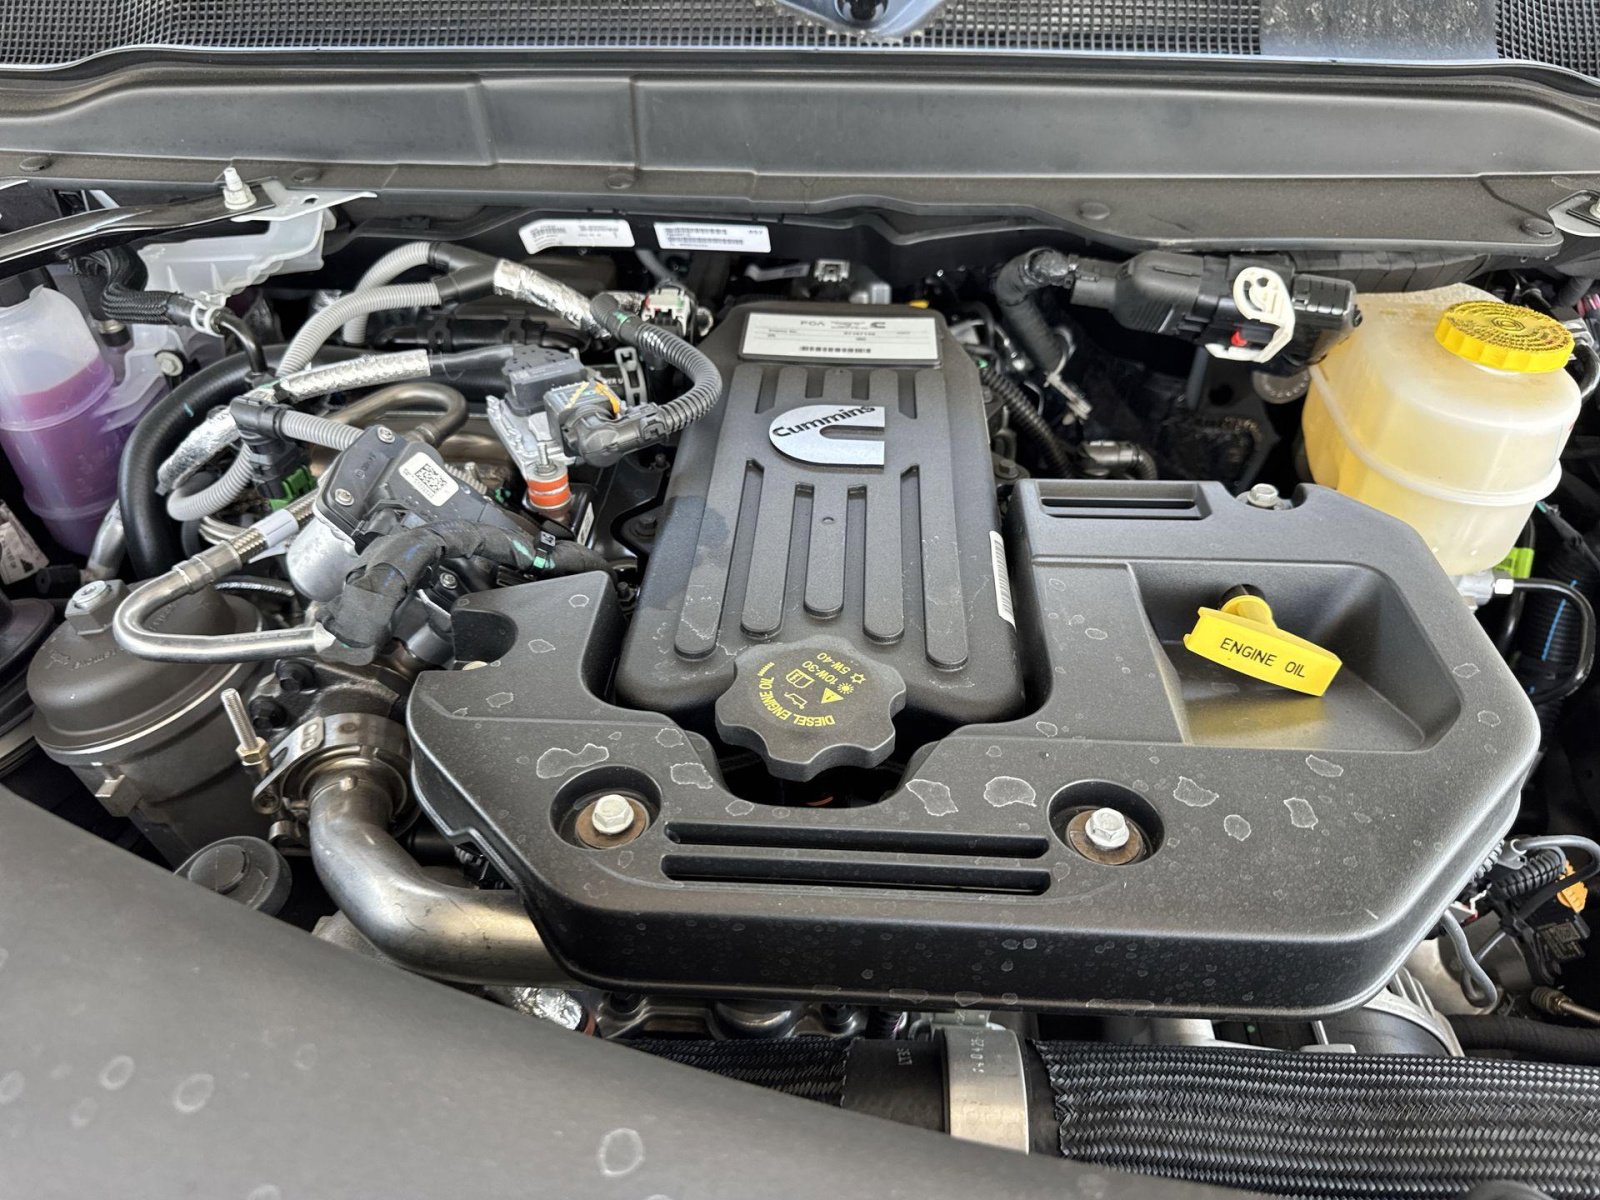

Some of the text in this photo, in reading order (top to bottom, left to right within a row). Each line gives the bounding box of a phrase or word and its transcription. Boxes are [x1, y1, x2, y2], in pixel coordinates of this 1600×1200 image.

[772, 406, 876, 437] Cummins
[802, 660, 838, 685] 10W-30
[816, 652, 851, 675] 5W-40
[1219, 637, 1306, 678] ENGINE OIL
[758, 676, 836, 727] DIESEL ENGINE OIL
